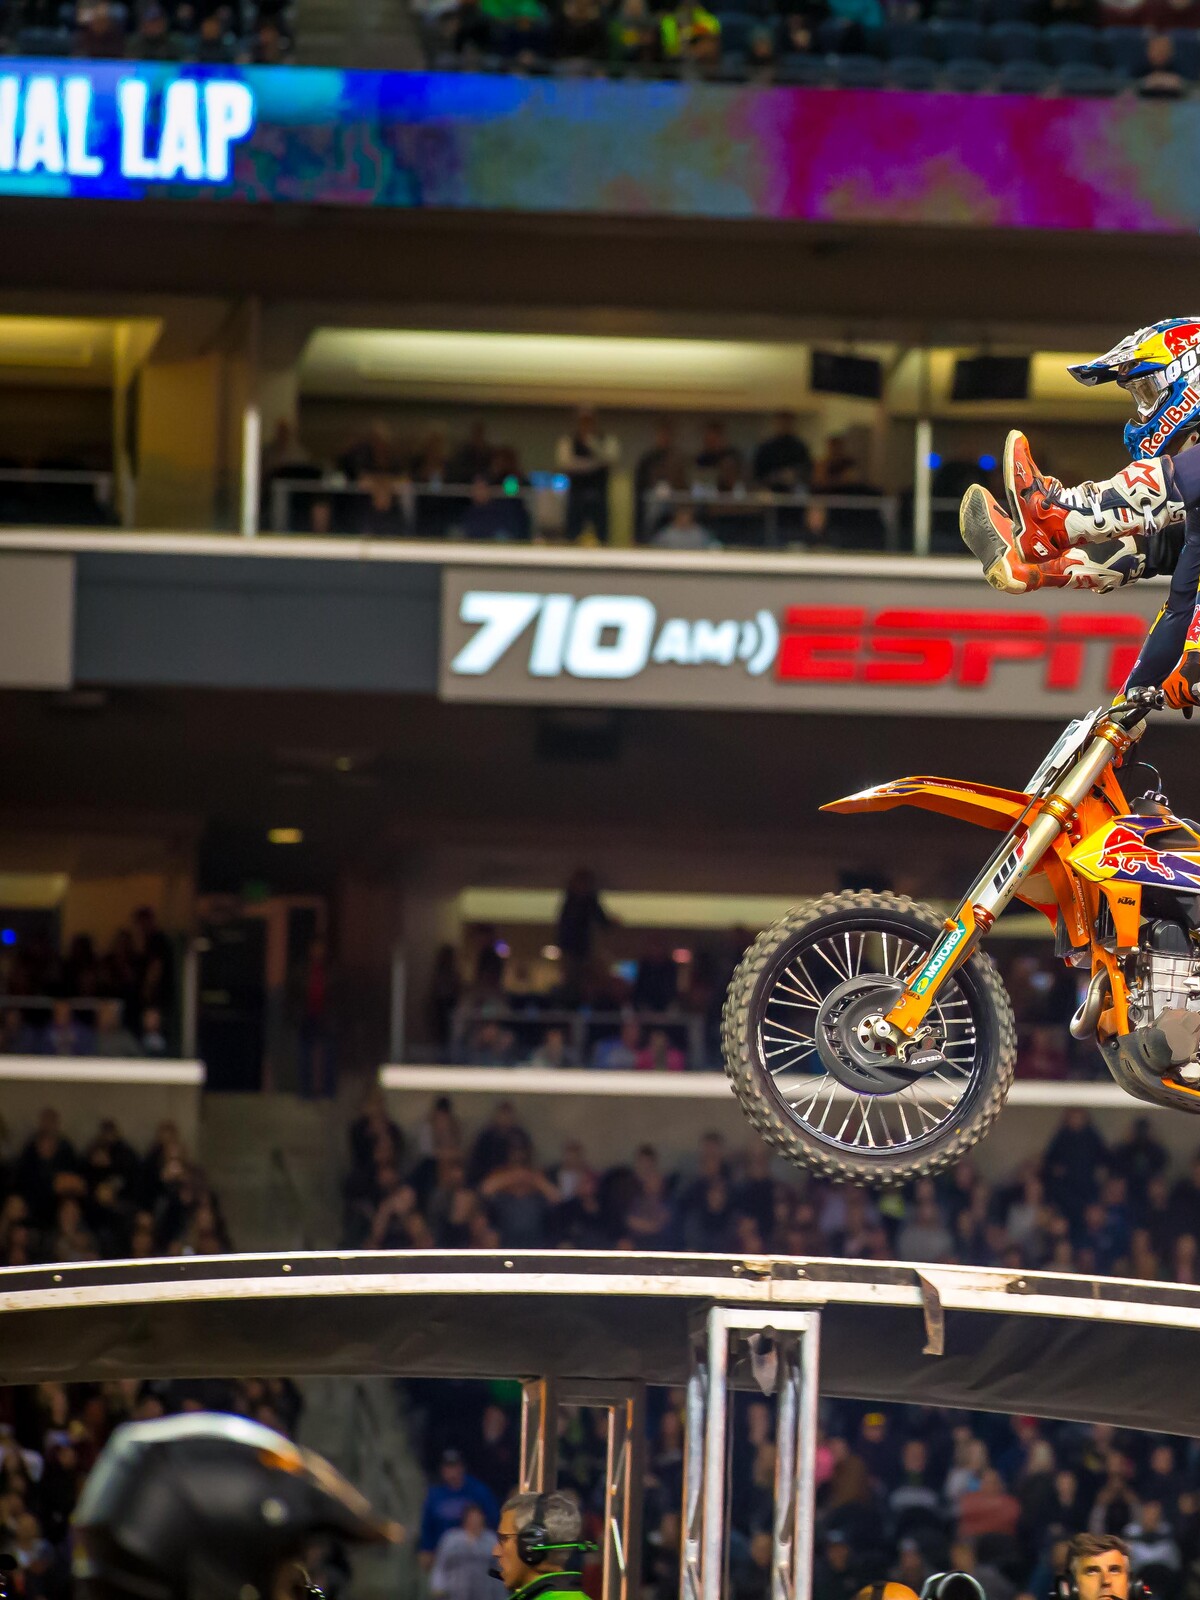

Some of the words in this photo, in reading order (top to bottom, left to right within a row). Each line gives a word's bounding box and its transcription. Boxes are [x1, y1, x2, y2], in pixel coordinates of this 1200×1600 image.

[118, 79, 253, 182] LAP
[1139, 415, 1175, 457] Red
[451, 590, 657, 680] 710
[653, 618, 740, 667] AM
[774, 605, 1147, 692] ESPN
[1117, 897, 1136, 906] KTM
[924, 927, 965, 979] MOTOREX
